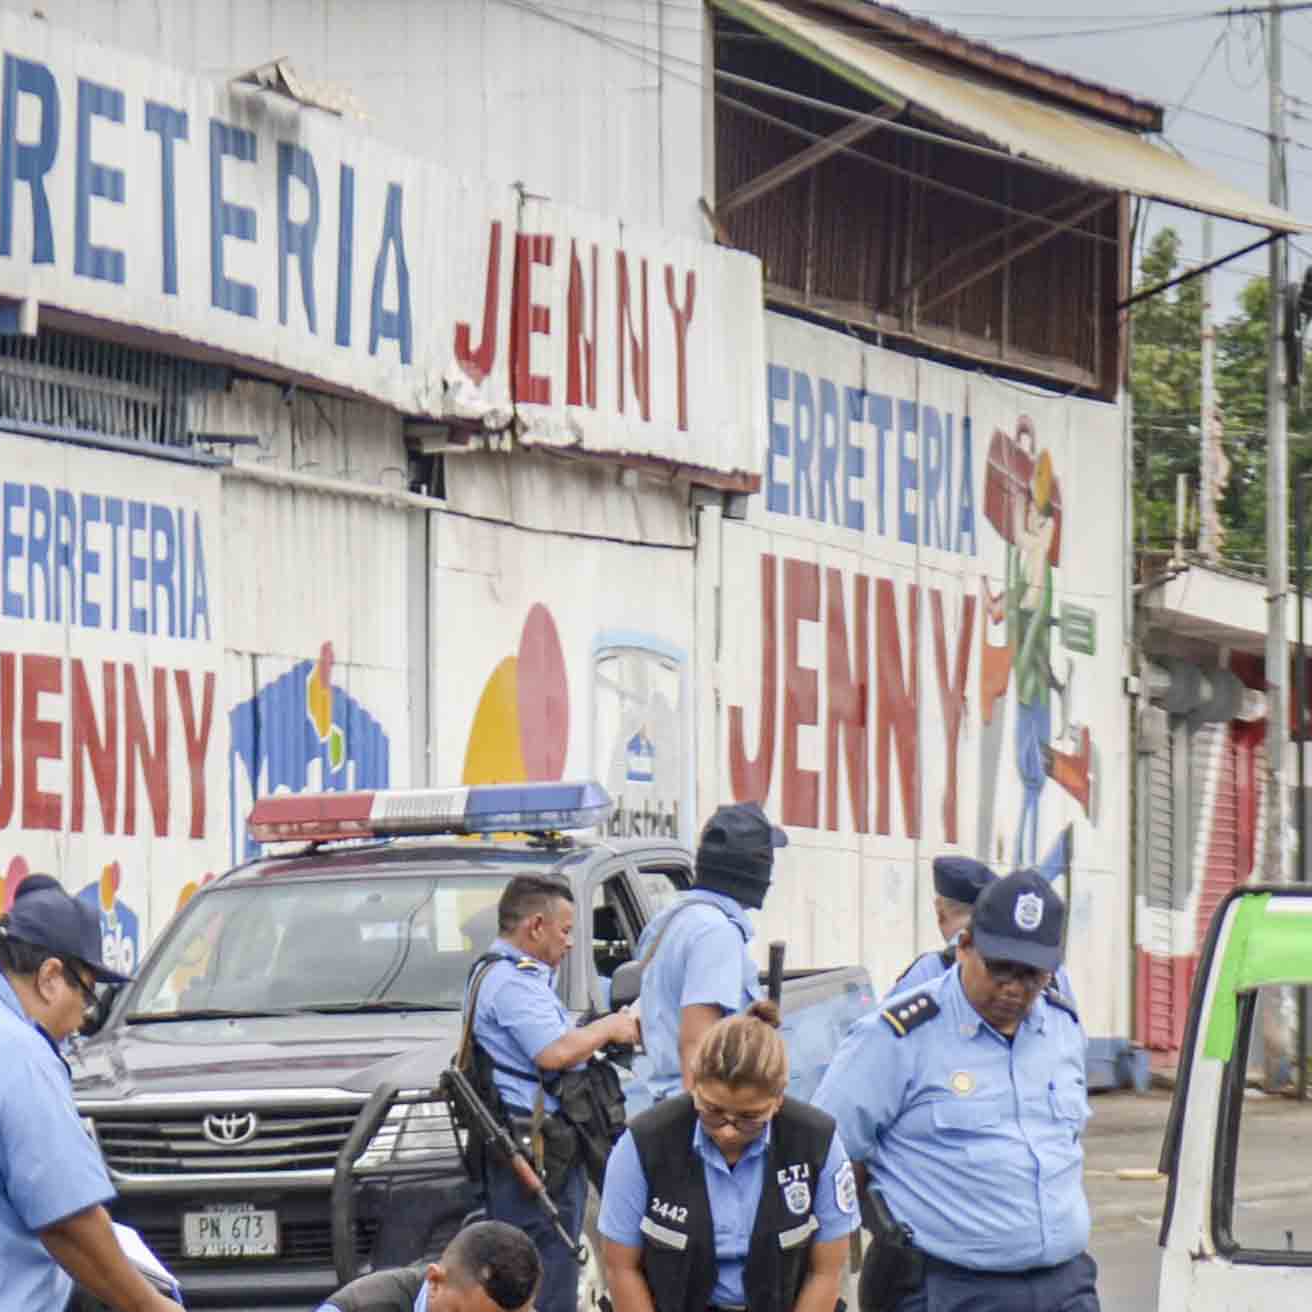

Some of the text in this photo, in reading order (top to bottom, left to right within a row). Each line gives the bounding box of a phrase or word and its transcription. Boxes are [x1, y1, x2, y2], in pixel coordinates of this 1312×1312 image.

[454, 219, 696, 432] JENNY
[766, 363, 978, 557] ERRETERIA
[727, 552, 977, 844] JENNY
[199, 1214, 264, 1240] PN 673
[651, 1197, 688, 1224] 2442
